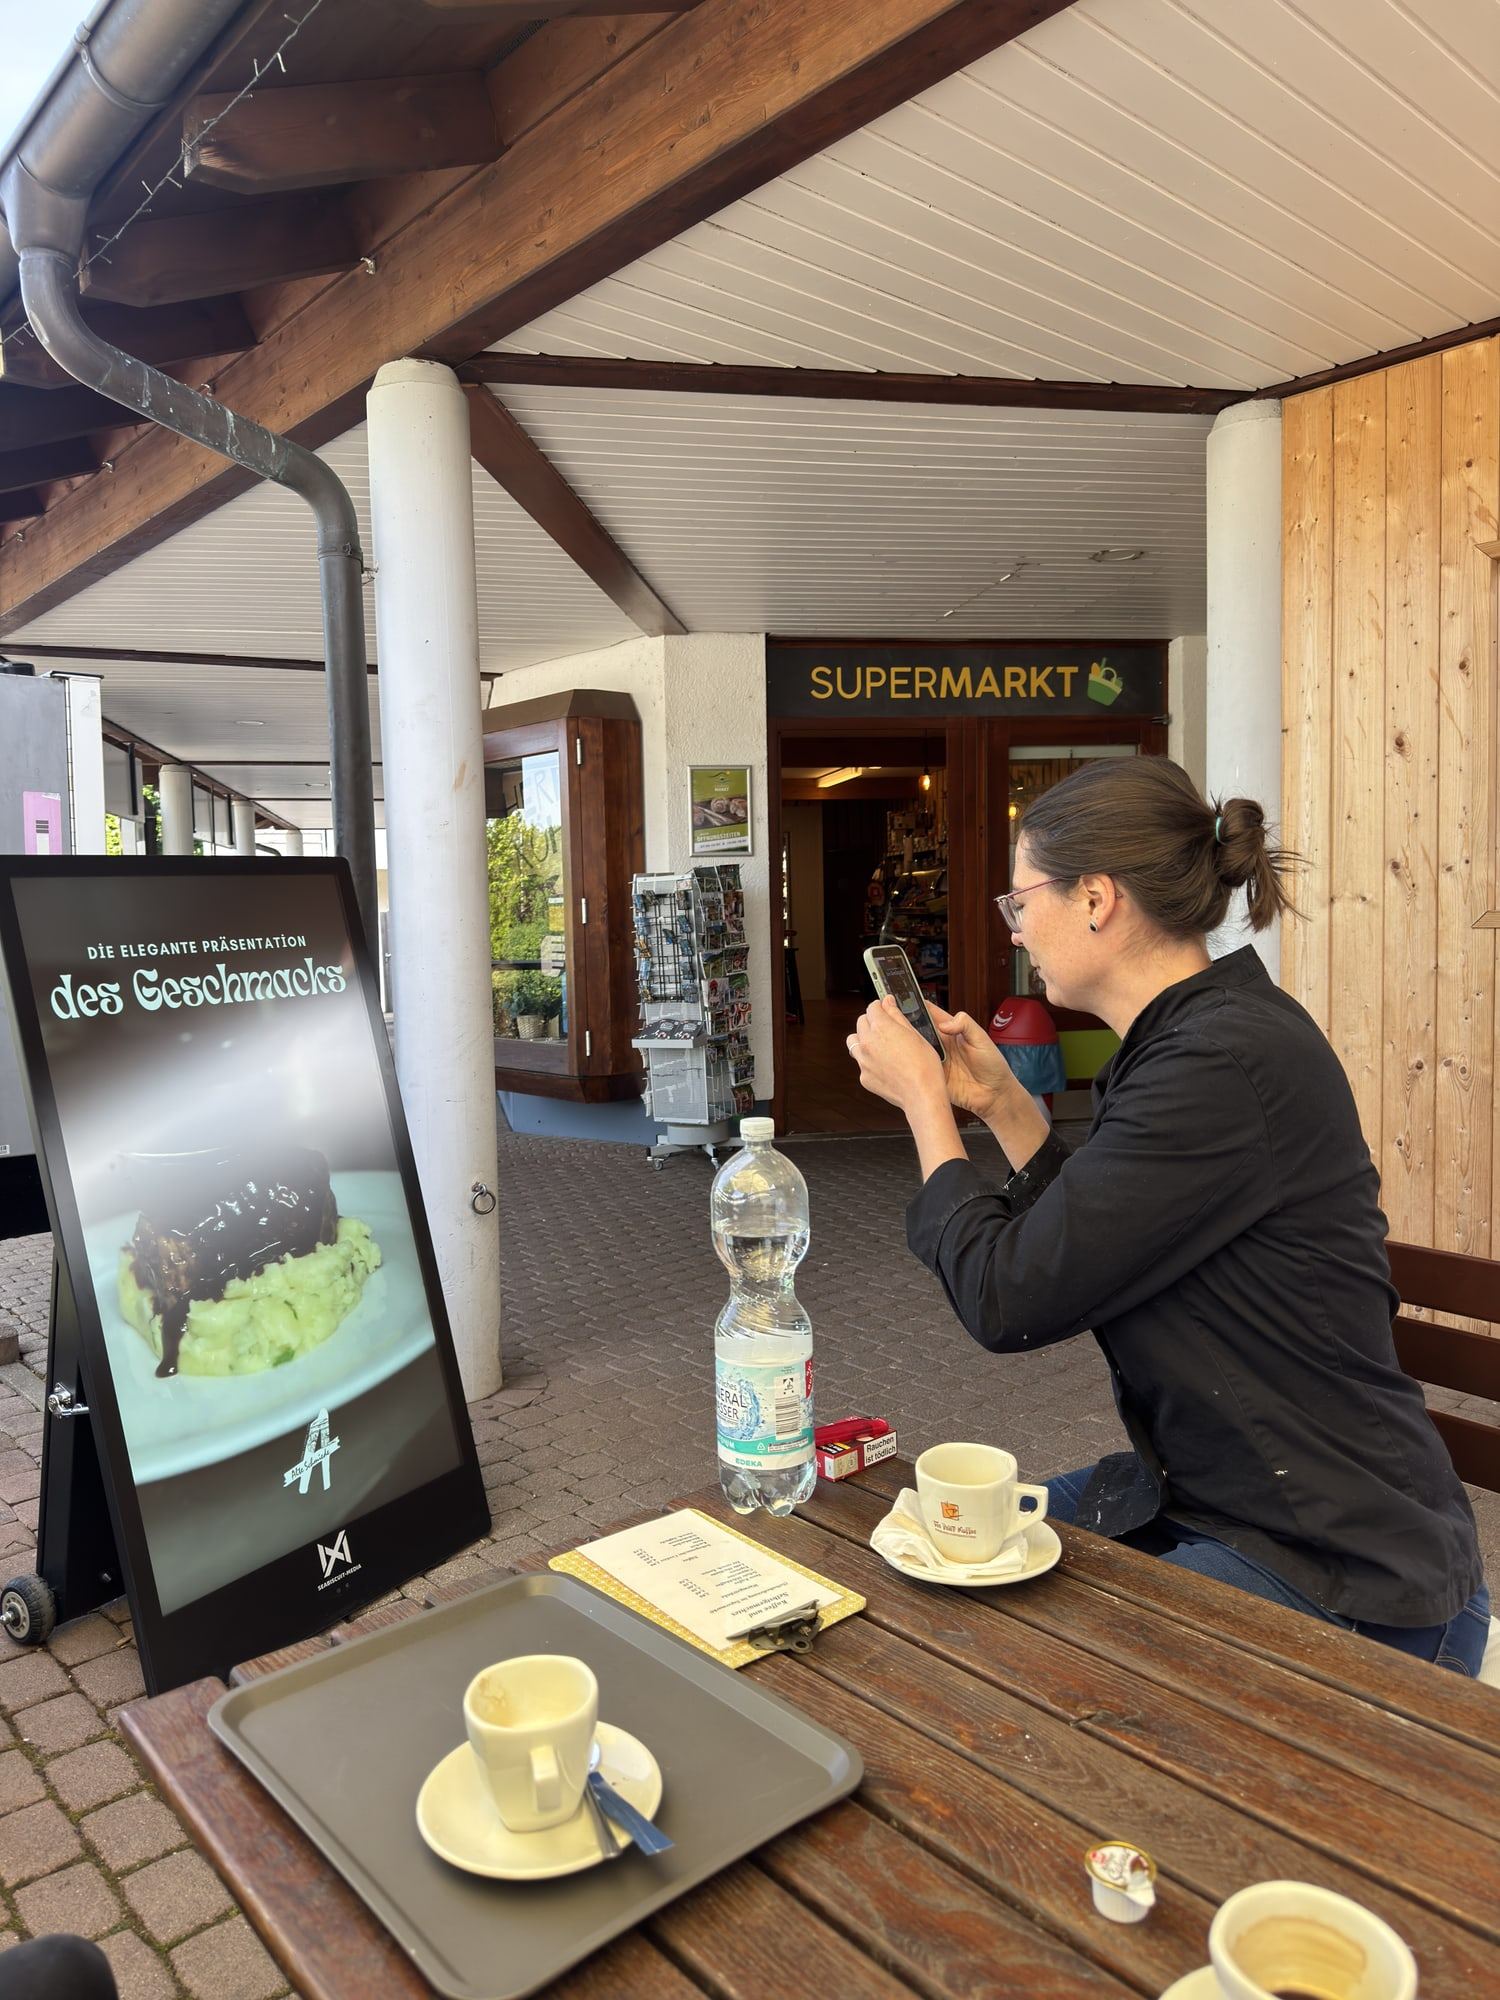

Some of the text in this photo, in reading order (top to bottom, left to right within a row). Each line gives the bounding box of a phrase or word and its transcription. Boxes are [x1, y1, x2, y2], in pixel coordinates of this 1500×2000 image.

[810, 666, 1079, 699] SUPERMARKT
[120, 941, 198, 958] ELEGANTE
[50, 957, 347, 1020] des Geschmacks
[865, 1445, 896, 1465] ist tödlich
[866, 1436, 895, 1453] Rauchen
[291, 1448, 330, 1480] Alte Schmiede
[735, 1457, 763, 1468] EDEKA
[317, 1563, 362, 1591] SEABISCUIT-MEDIA
